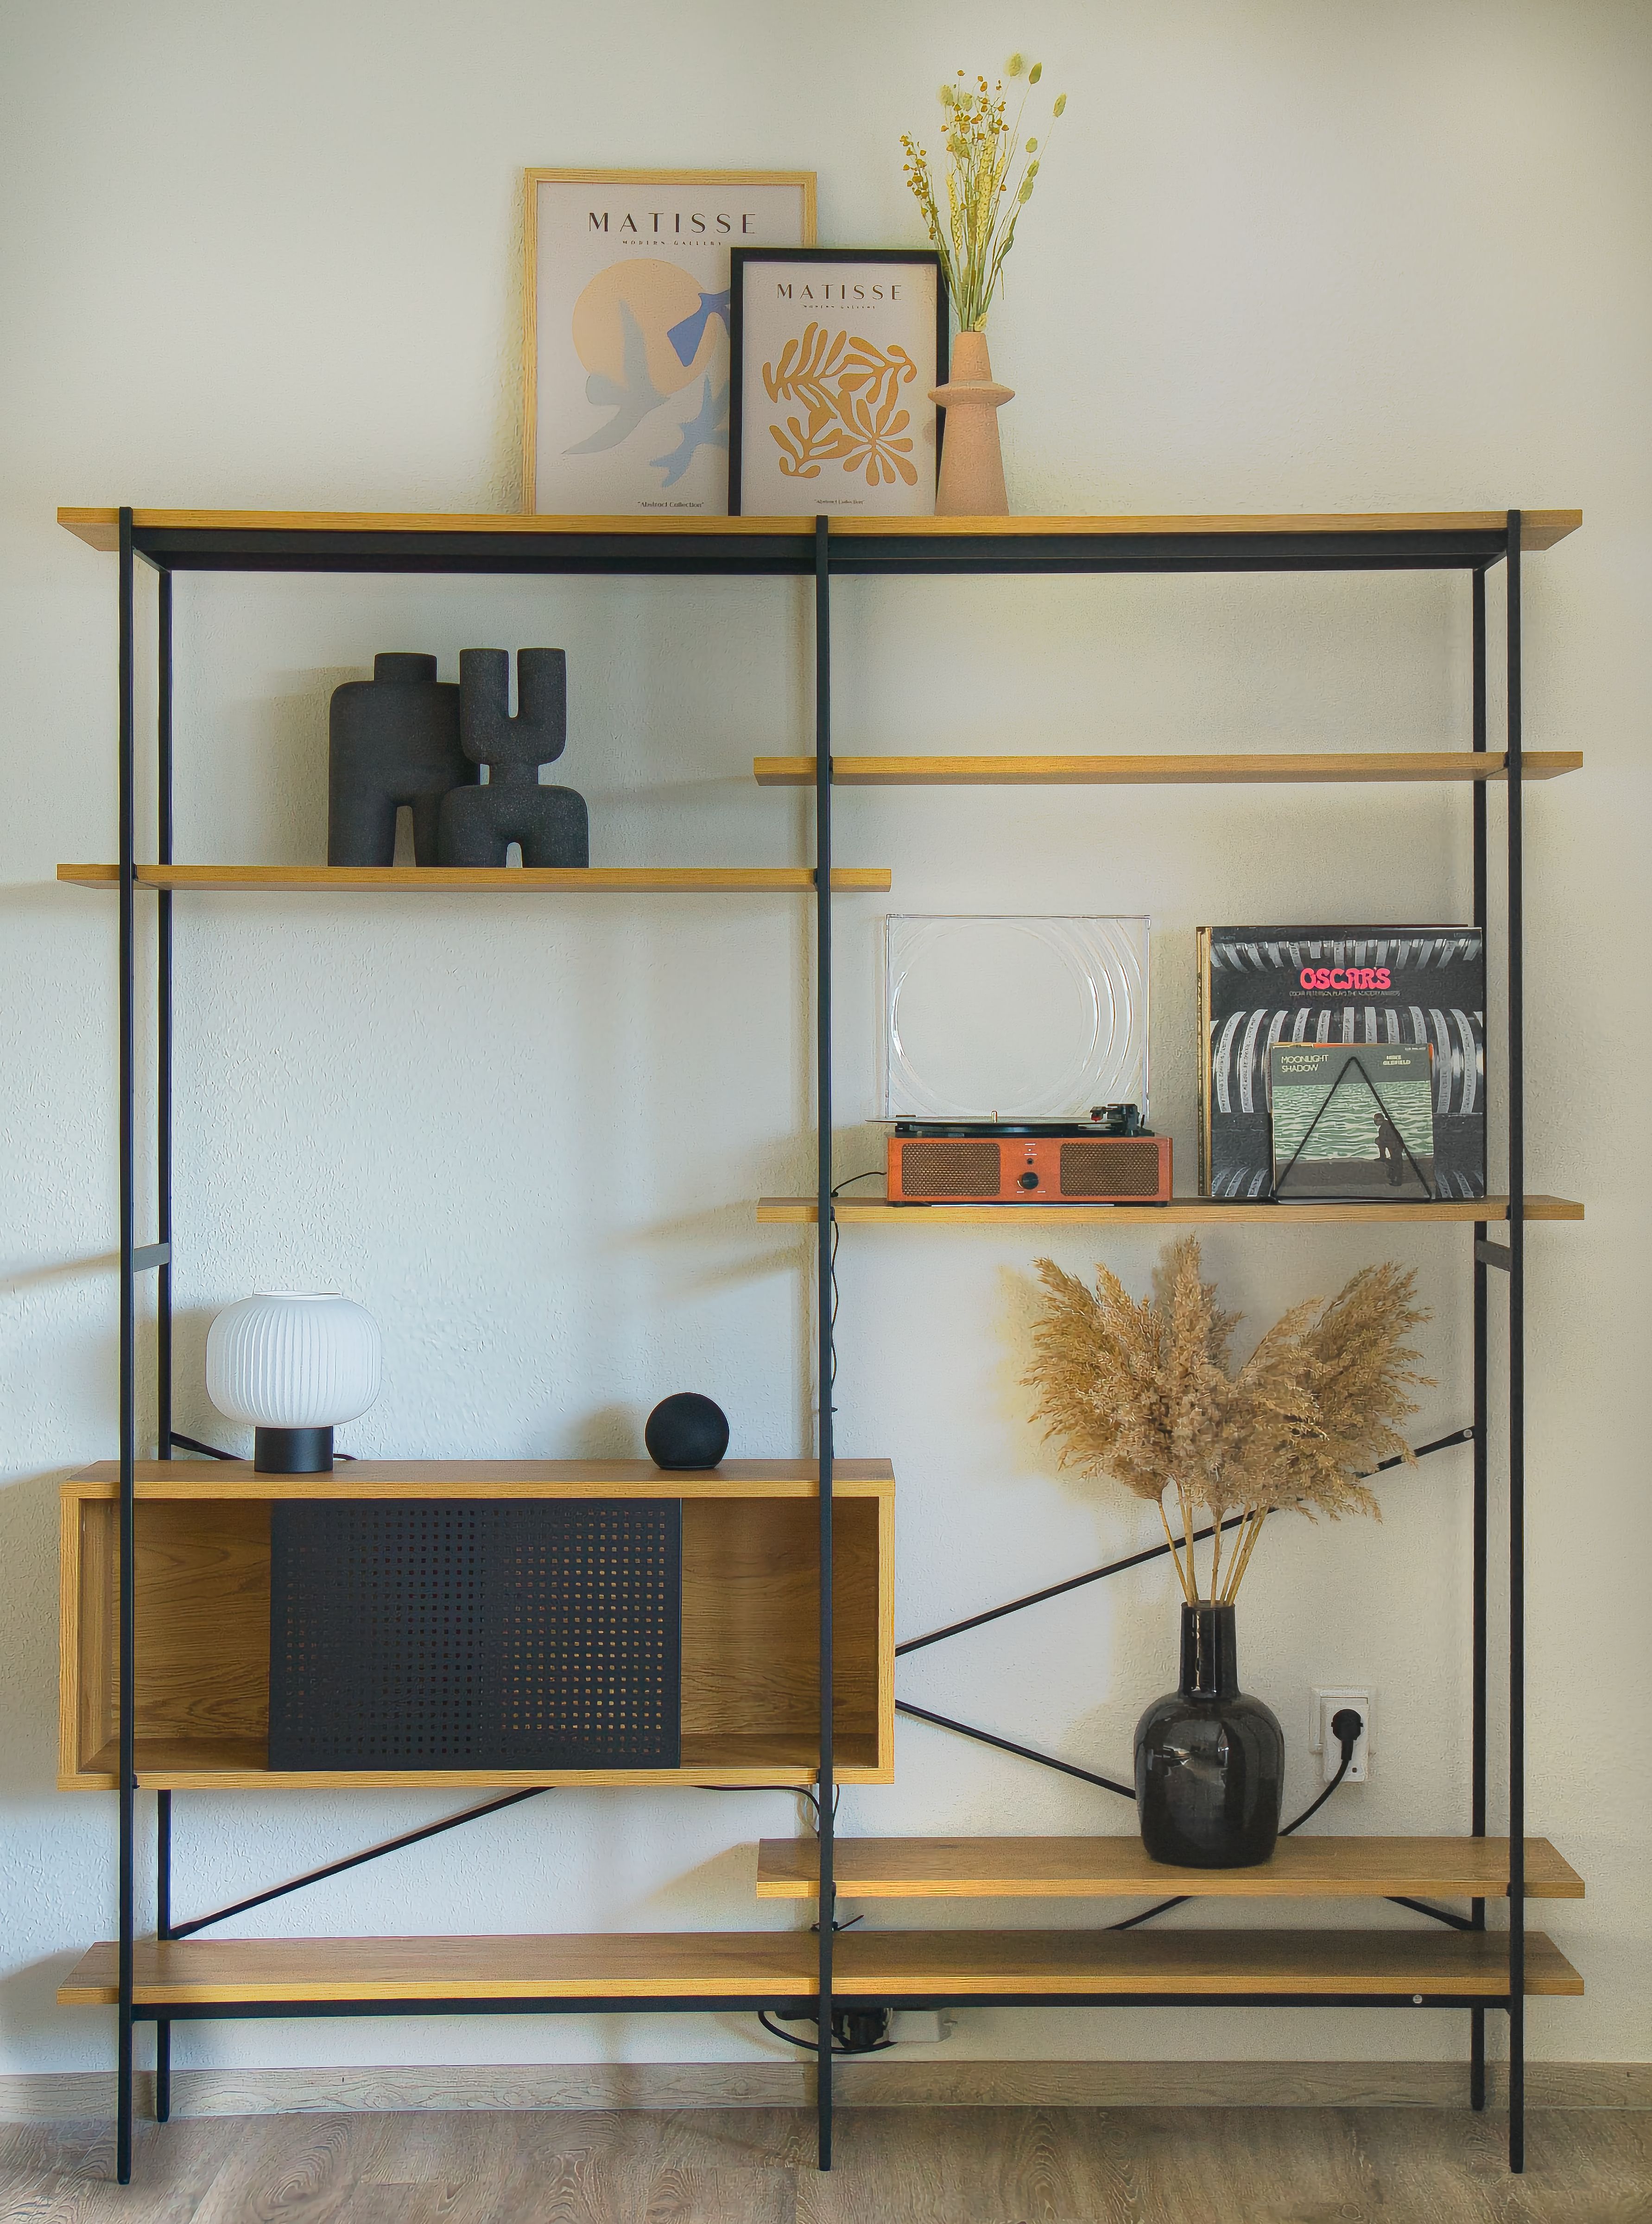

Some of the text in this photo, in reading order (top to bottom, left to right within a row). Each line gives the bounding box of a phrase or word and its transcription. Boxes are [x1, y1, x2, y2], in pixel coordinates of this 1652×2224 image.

[589, 212, 756, 234] MATISSE
[777, 284, 902, 300] MATISSE
[1281, 1054, 1329, 1064] MOONLIGHT
[1281, 1064, 1318, 1072] SHADOW
